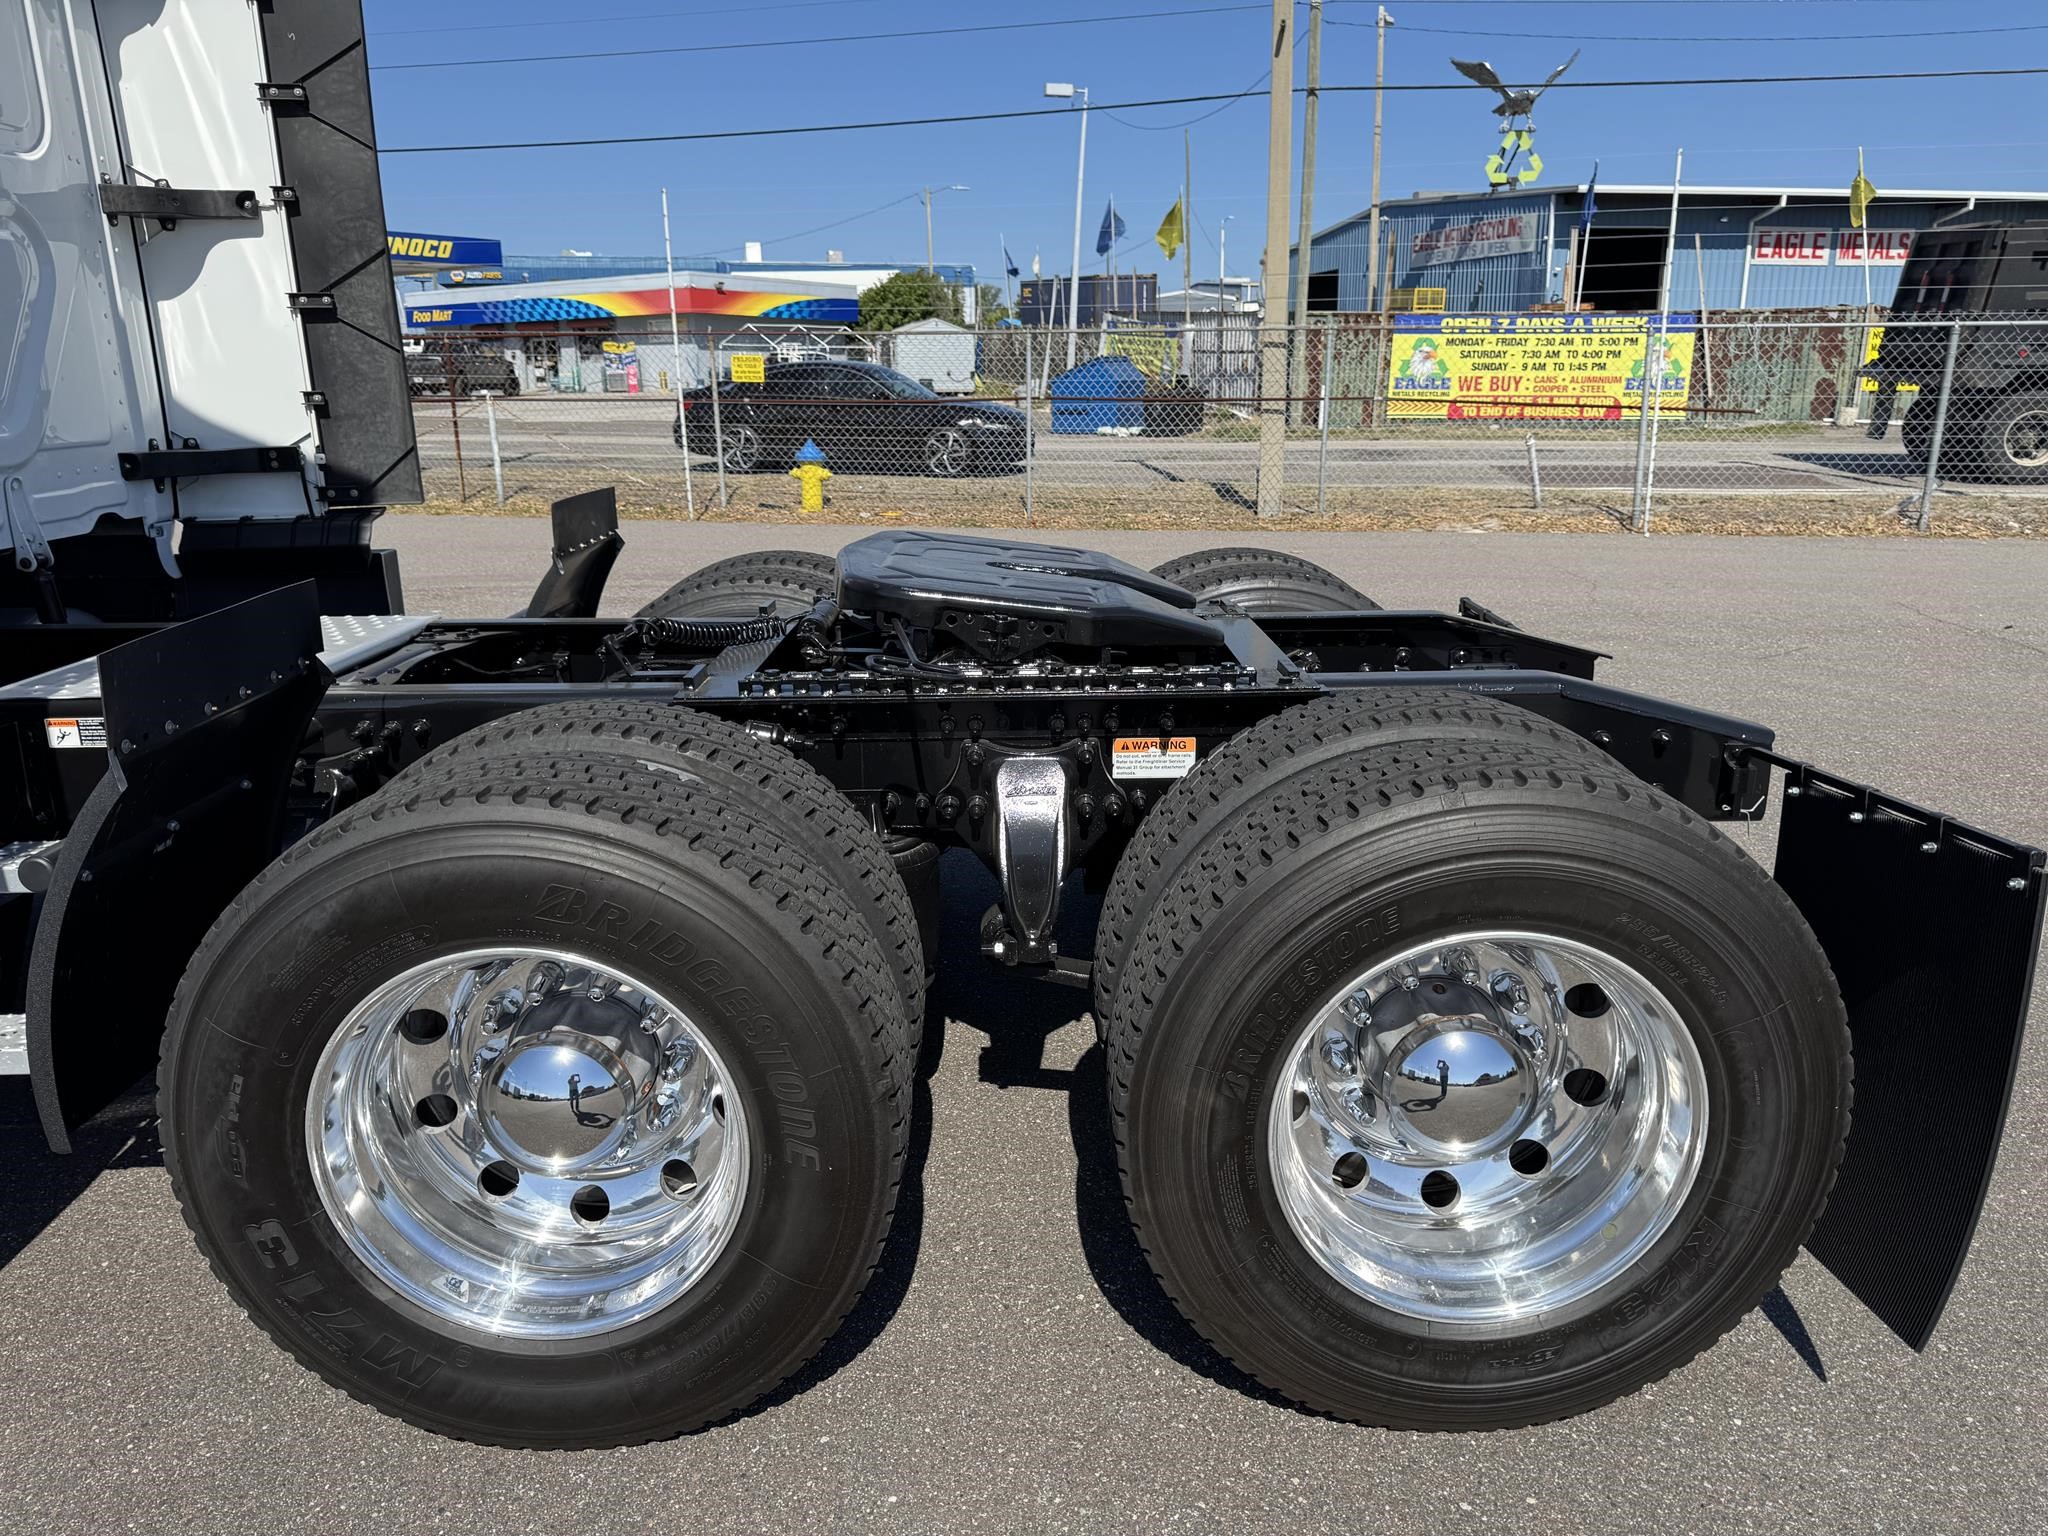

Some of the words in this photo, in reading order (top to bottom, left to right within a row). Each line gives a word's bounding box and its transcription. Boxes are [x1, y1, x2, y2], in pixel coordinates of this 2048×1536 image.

[387, 236, 454, 259] NOCO
[1756, 230, 1827, 260] EAGLE
[1839, 231, 1911, 261] METALS
[412, 311, 431, 323] FOOD
[432, 309, 453, 322] MART
[1440, 317, 1491, 333] OPEN
[1496, 318, 1511, 333] 7
[1515, 317, 1566, 333] DAYS
[1570, 317, 1586, 333] A
[1591, 316, 1649, 333] WEEK
[1445, 337, 1485, 347] MONDAY
[1495, 337, 1528, 347] FRIDAY
[1535, 337, 1556, 347] 7:30
[1558, 337, 1575, 347] AM
[1581, 337, 1593, 347] TO
[1599, 337, 1620, 347] 5:00
[1623, 337, 1639, 346] PM
[1459, 350, 1508, 359] SATURDAY
[1521, 350, 1542, 359] 7:30
[1544, 350, 1560, 359] AM
[1567, 350, 1578, 359] TO
[1582, 350, 1603, 359] 4:00
[1605, 350, 1622, 359] PM
[1471, 362, 1509, 372] SUNDAY
[1521, 362, 1528, 371] 9
[1531, 362, 1546, 372] AM
[1553, 362, 1565, 371] TO
[1569, 362, 1588, 371] 1:45
[1591, 362, 1607, 372] PM
[1393, 377, 1451, 390] EAGLE
[1458, 375, 1484, 392] WE
[1489, 375, 1523, 392] BUY
[1533, 376, 1558, 384] CANS
[1570, 376, 1622, 384] ALUMINIUM
[1624, 376, 1686, 391] EALE
[1533, 385, 1568, 393] COOPER
[1579, 385, 1607, 393] STEEL
[1580, 396, 1614, 406] PRIOR
[1462, 407, 1477, 416] TO
[1480, 407, 1502, 416] END
[1505, 407, 1520, 416] OF
[1523, 407, 1580, 416] BUSINESS
[1583, 407, 1606, 416] DAY
[1131, 740, 1187, 750] WARNING
[1218, 906, 1401, 1102] BRIDGESTONE
[534, 883, 821, 1172] BRIDGESTONE
[1611, 1215, 1727, 1329] R123
[243, 1218, 447, 1389] M713
